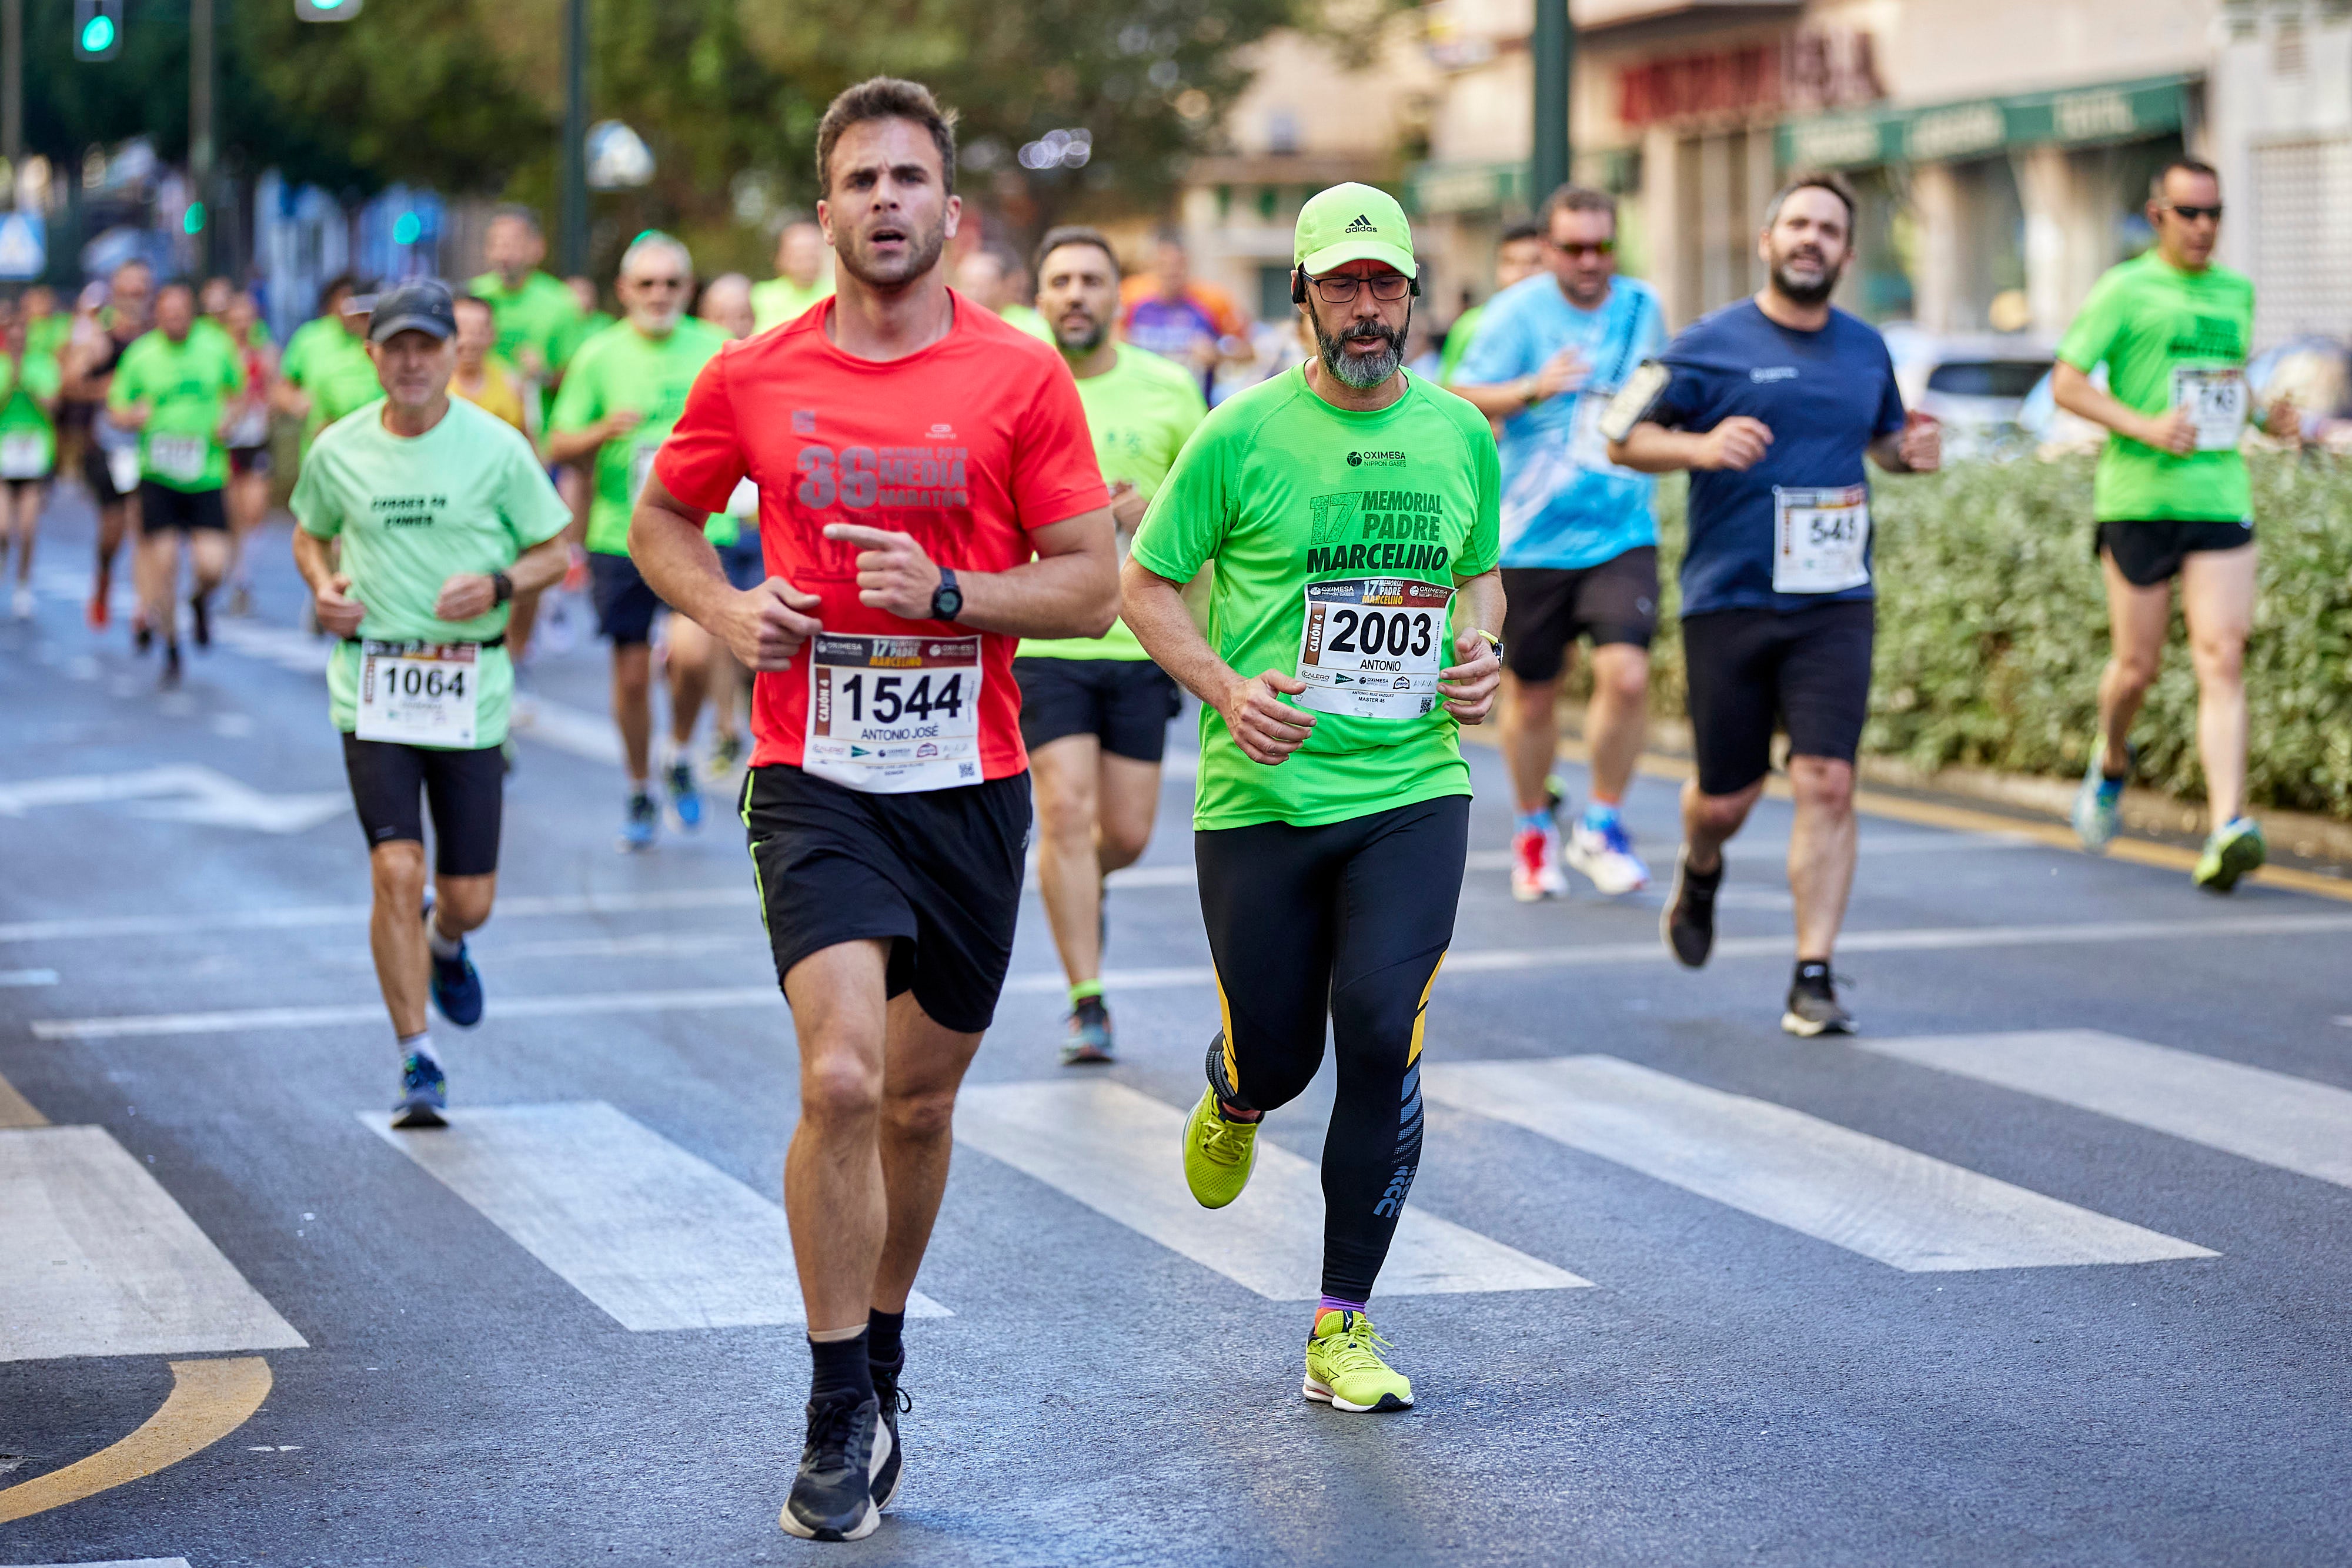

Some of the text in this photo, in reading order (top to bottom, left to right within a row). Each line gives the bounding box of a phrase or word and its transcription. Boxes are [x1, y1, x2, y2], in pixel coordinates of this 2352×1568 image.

[1345, 225, 1378, 233] adidas
[1363, 451, 1406, 460] OXIMESA
[797, 445, 878, 510] 36
[878, 459, 966, 487] MEDIA
[878, 487, 967, 508] MARATÓN
[1361, 490, 1442, 515] MEMORIAL
[1309, 491, 1363, 546] 17
[1362, 513, 1441, 542] PADRE
[1307, 543, 1449, 574] MARCELINO
[1364, 580, 1379, 596] 17
[1379, 586, 1402, 596] PADRE
[1419, 586, 1448, 595] OXIMESA
[1361, 595, 1404, 606] MARCELINO
[1309, 624, 1322, 653] CAJÓN
[1328, 609, 1432, 657] 2003
[872, 639, 890, 657] 17
[890, 646, 920, 657] PADRE
[869, 656, 923, 667] MARCELINO
[1360, 659, 1402, 672] ANTONIO
[384, 666, 466, 700] 1064
[1303, 671, 1330, 680] CALERO
[818, 689, 830, 722] CAJÓN
[842, 673, 963, 724] 1544
[861, 724, 940, 741] ANTONIO JOSÉ
